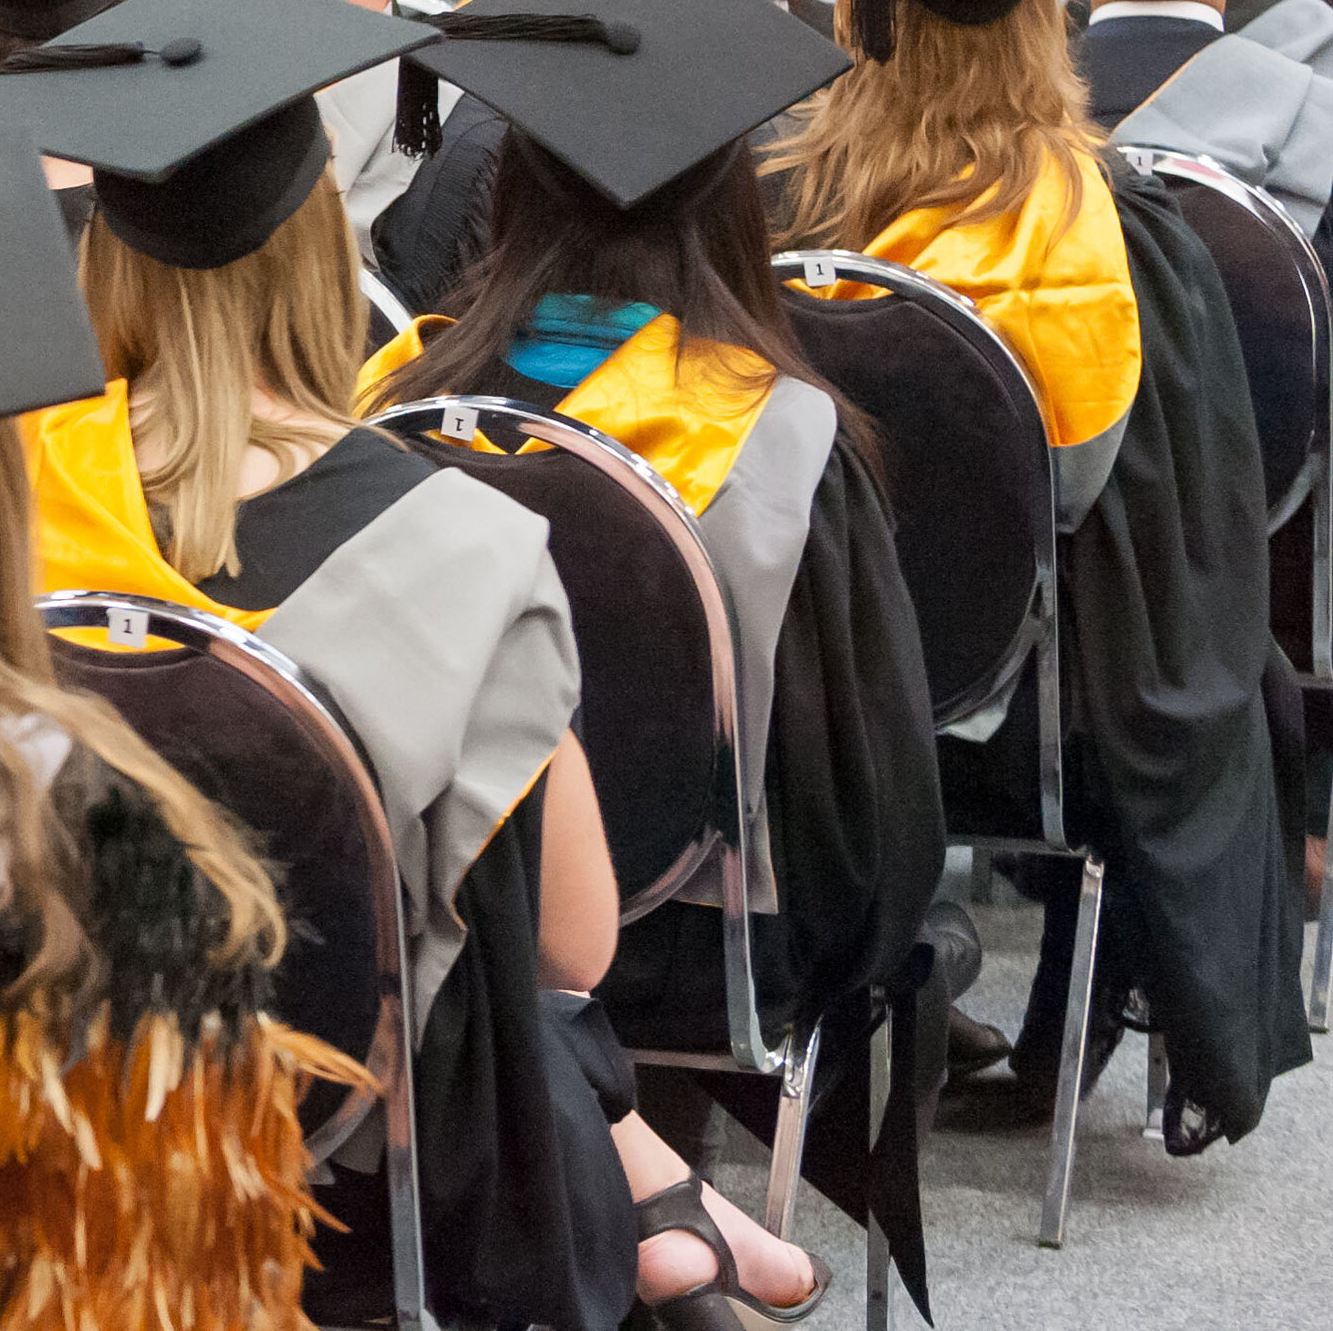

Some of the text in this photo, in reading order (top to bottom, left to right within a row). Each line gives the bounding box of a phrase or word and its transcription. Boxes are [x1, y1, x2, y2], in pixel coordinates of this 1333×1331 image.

[816, 263, 824, 276] 1
[454, 416, 465, 432] 1
[123, 618, 133, 635] 1
